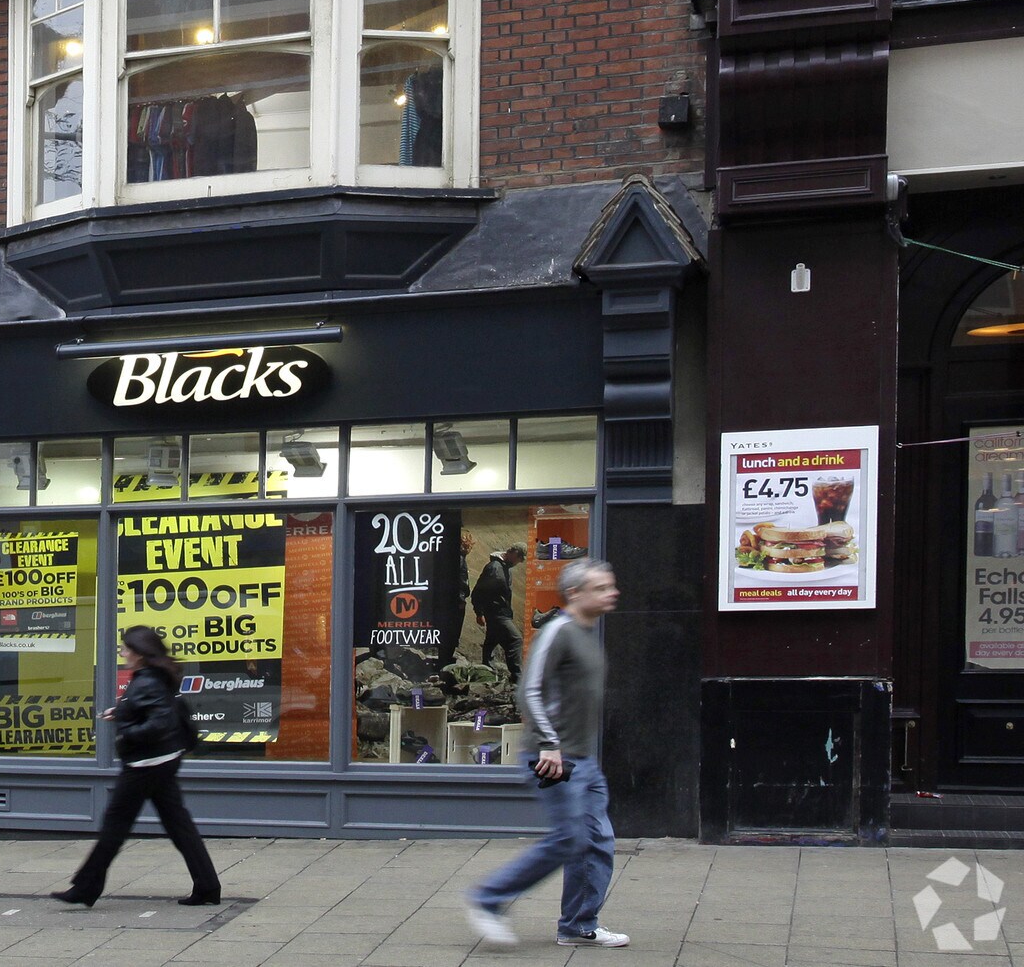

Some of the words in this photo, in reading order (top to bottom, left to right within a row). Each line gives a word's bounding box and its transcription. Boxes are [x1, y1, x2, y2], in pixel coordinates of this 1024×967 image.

[112, 346, 308, 407] Blacks
[742, 457, 776, 469] lunch
[778, 456, 800, 467] and
[802, 458, 810, 466] a
[812, 454, 845, 466] drink
[742, 477, 809, 499] £4.75
[286, 525, 332, 536] ERRE
[372, 512, 445, 554] 20%
[418, 536, 444, 552] off
[2, 539, 69, 555] CLEARANCE
[146, 535, 242, 571] EVENT
[18, 554, 54, 567] EVENT
[44, 572, 76, 585] OFF
[384, 555, 429, 586] ALL
[2, 591, 25, 599] 100'S
[41, 586, 64, 597] BIG
[210, 583, 282, 609] OFF
[761, 589, 782, 597] deals
[799, 589, 814, 598] day
[814, 589, 837, 597] every
[837, 589, 853, 597] day
[27, 597, 73, 605] PRODUCTS
[978, 607, 1024, 625] 4.95
[172, 625, 199, 639] OF
[204, 615, 256, 638] BIG
[370, 629, 441, 645] FOOTWEAR
[172, 639, 277, 656] PRODUCTS
[205, 677, 265, 692] berghaus
